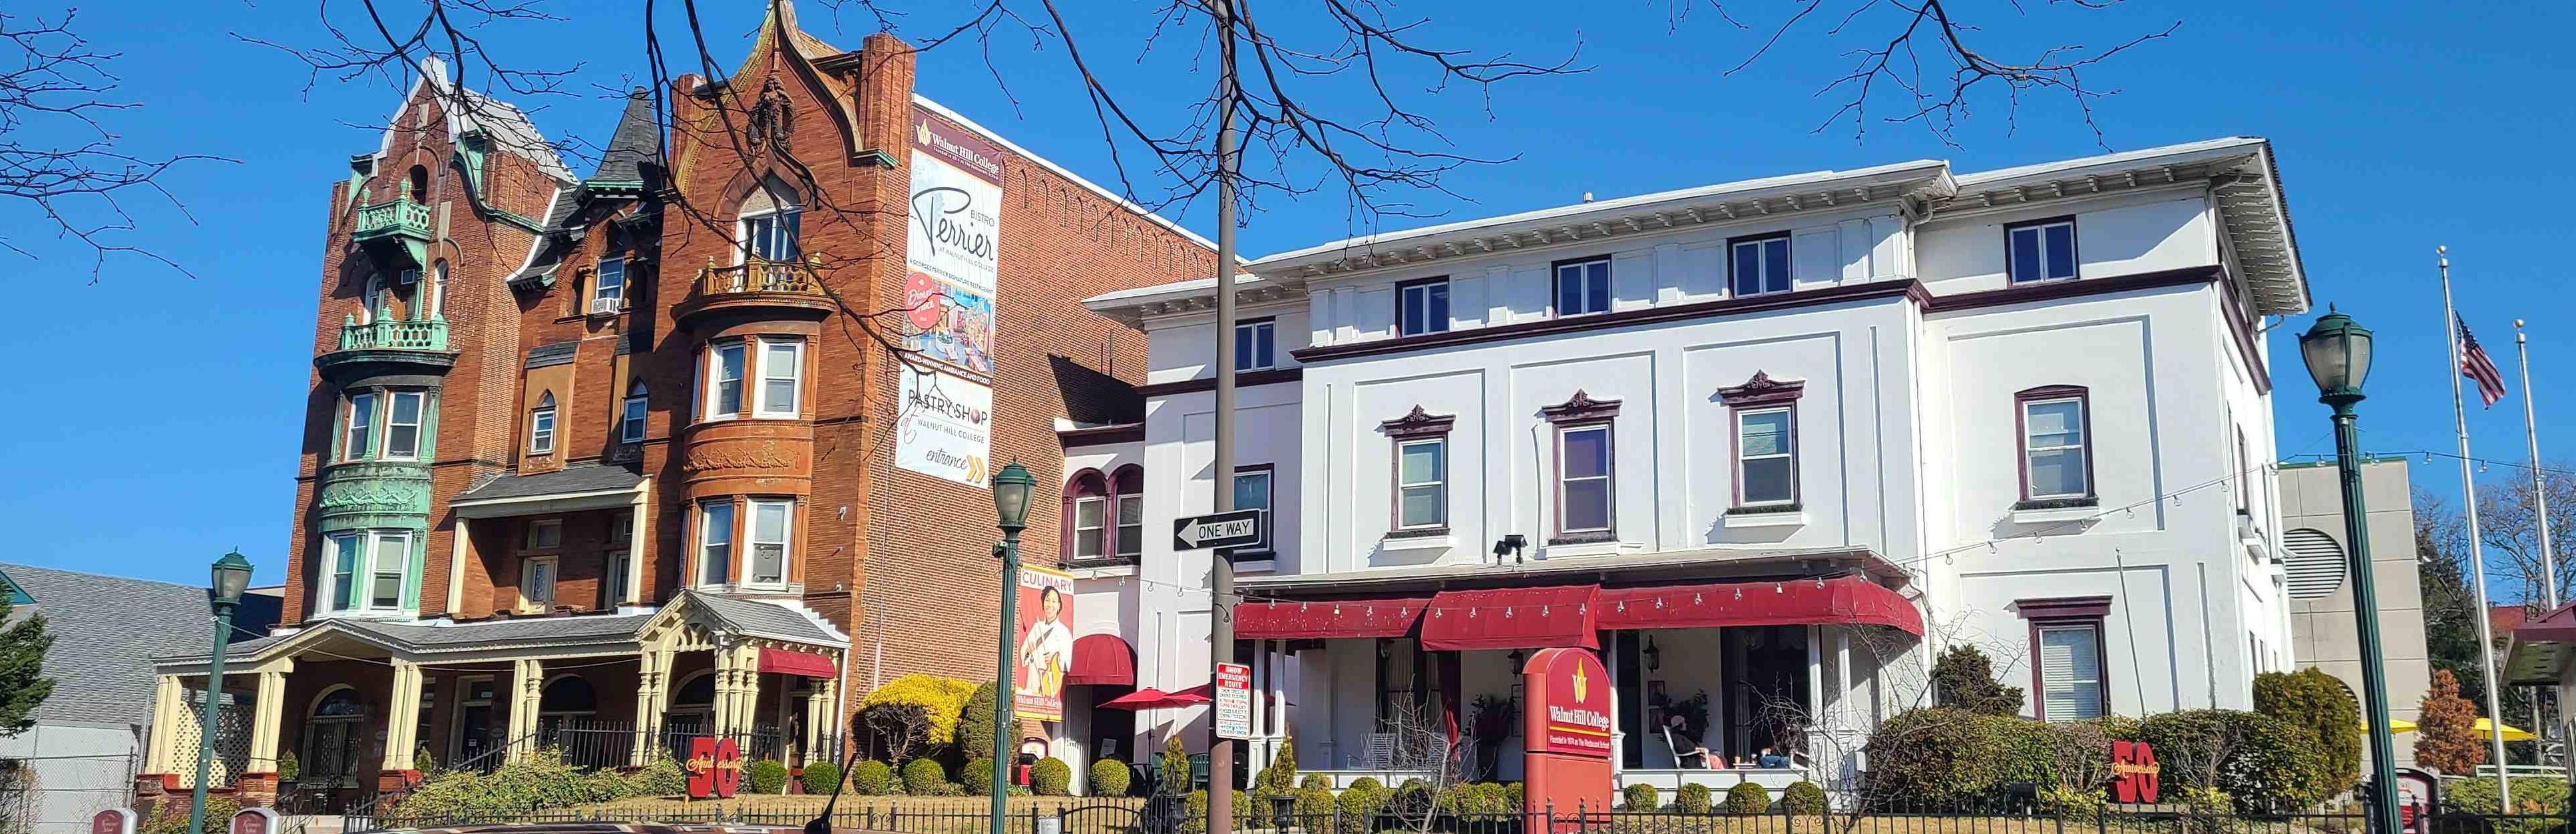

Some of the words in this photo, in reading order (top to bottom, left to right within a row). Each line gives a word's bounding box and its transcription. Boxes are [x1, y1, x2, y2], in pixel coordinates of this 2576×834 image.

[933, 133, 959, 154] Walnut
[959, 146, 973, 162] Hill
[974, 154, 998, 174] College
[912, 186, 993, 261] Perrier
[970, 209, 994, 227] BISTRO
[946, 250, 964, 261] WALNUT
[965, 256, 973, 265] HILL
[974, 260, 994, 273] COLLEGE
[905, 353, 944, 371] AWARD-WINNING
[944, 365, 967, 377] AMBIANCE
[977, 375, 990, 385] FOOD
[909, 389, 953, 417] PASTRY
[955, 403, 988, 425] SHOP
[918, 418, 943, 432] WALNUT
[944, 426, 957, 437] HILL
[958, 431, 984, 443] COLLEGE
[926, 447, 967, 470] entrance
[1199, 524, 1221, 538] ONE
[1226, 521, 1250, 535] WAY
[1022, 571, 1072, 592] CULINARY
[1218, 672, 1248, 682] EMERGENCY
[1224, 680, 1243, 689] ROUTE
[1016, 695, 1033, 705] Walnut
[1034, 697, 1044, 706] Hill
[1550, 706, 1574, 724] Walnut
[1574, 709, 1586, 726] Hill
[1586, 712, 1610, 731] College
[688, 736, 740, 798] 50
[2113, 741, 2159, 803] 50
